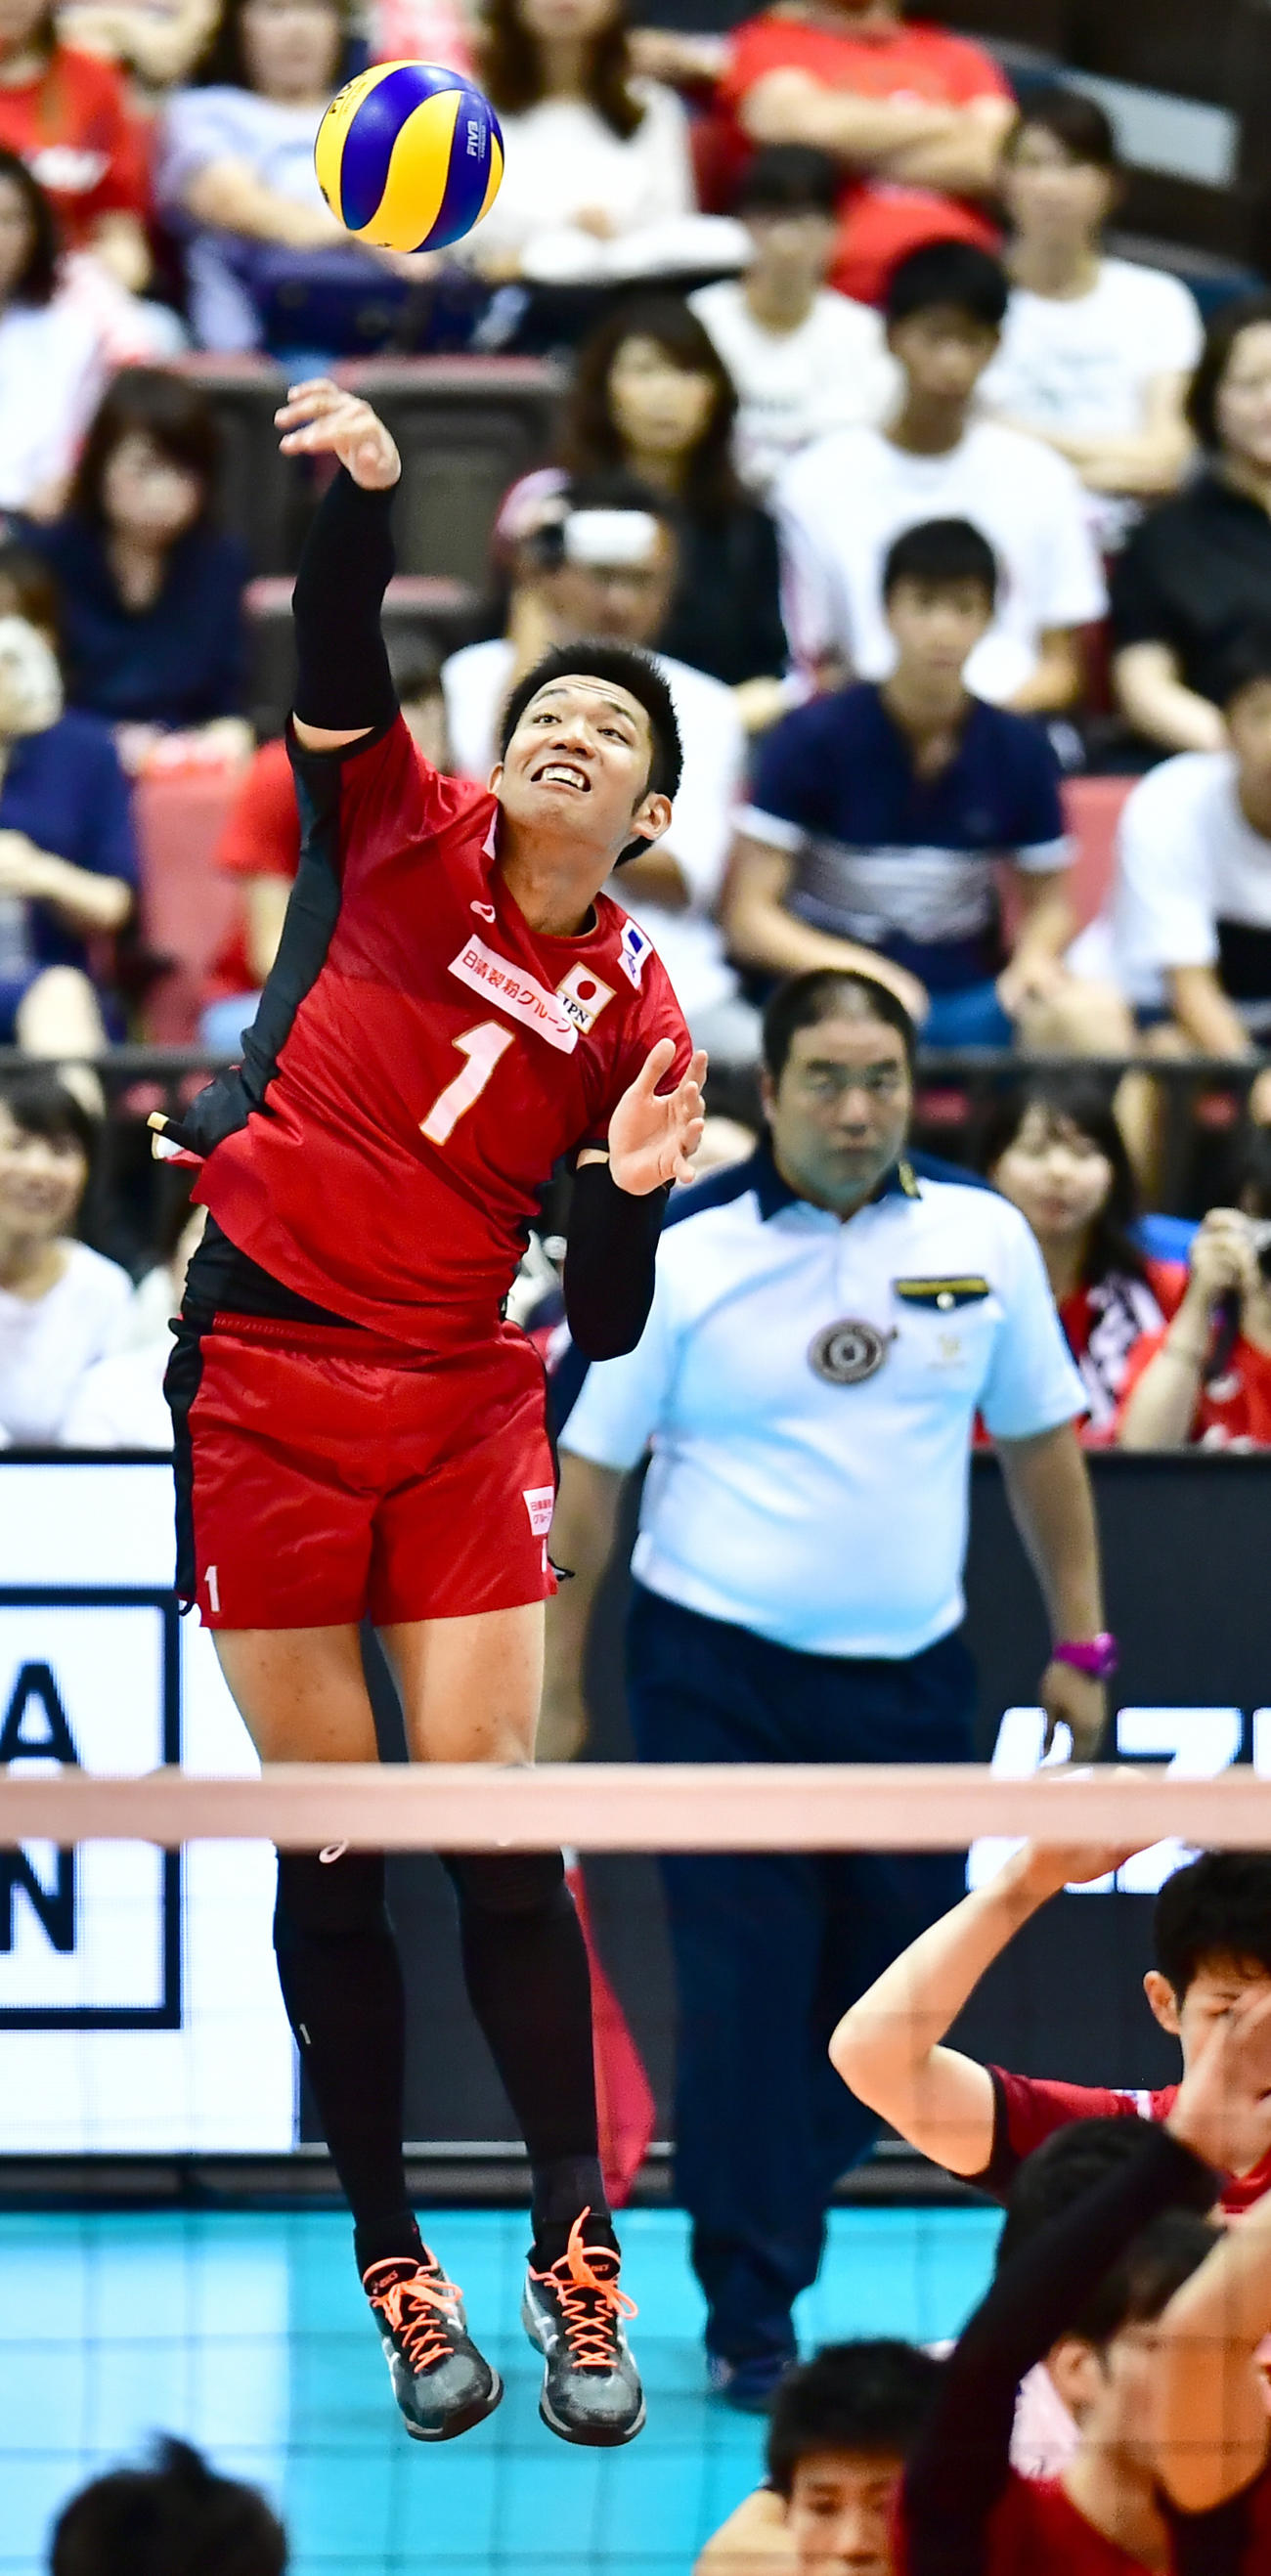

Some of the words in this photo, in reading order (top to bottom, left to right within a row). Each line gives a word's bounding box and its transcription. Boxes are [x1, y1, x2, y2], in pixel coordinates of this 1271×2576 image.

[466, 119, 479, 157] FIVB
[417, 1019, 516, 1147] 1
[204, 1565, 221, 1613] 1
